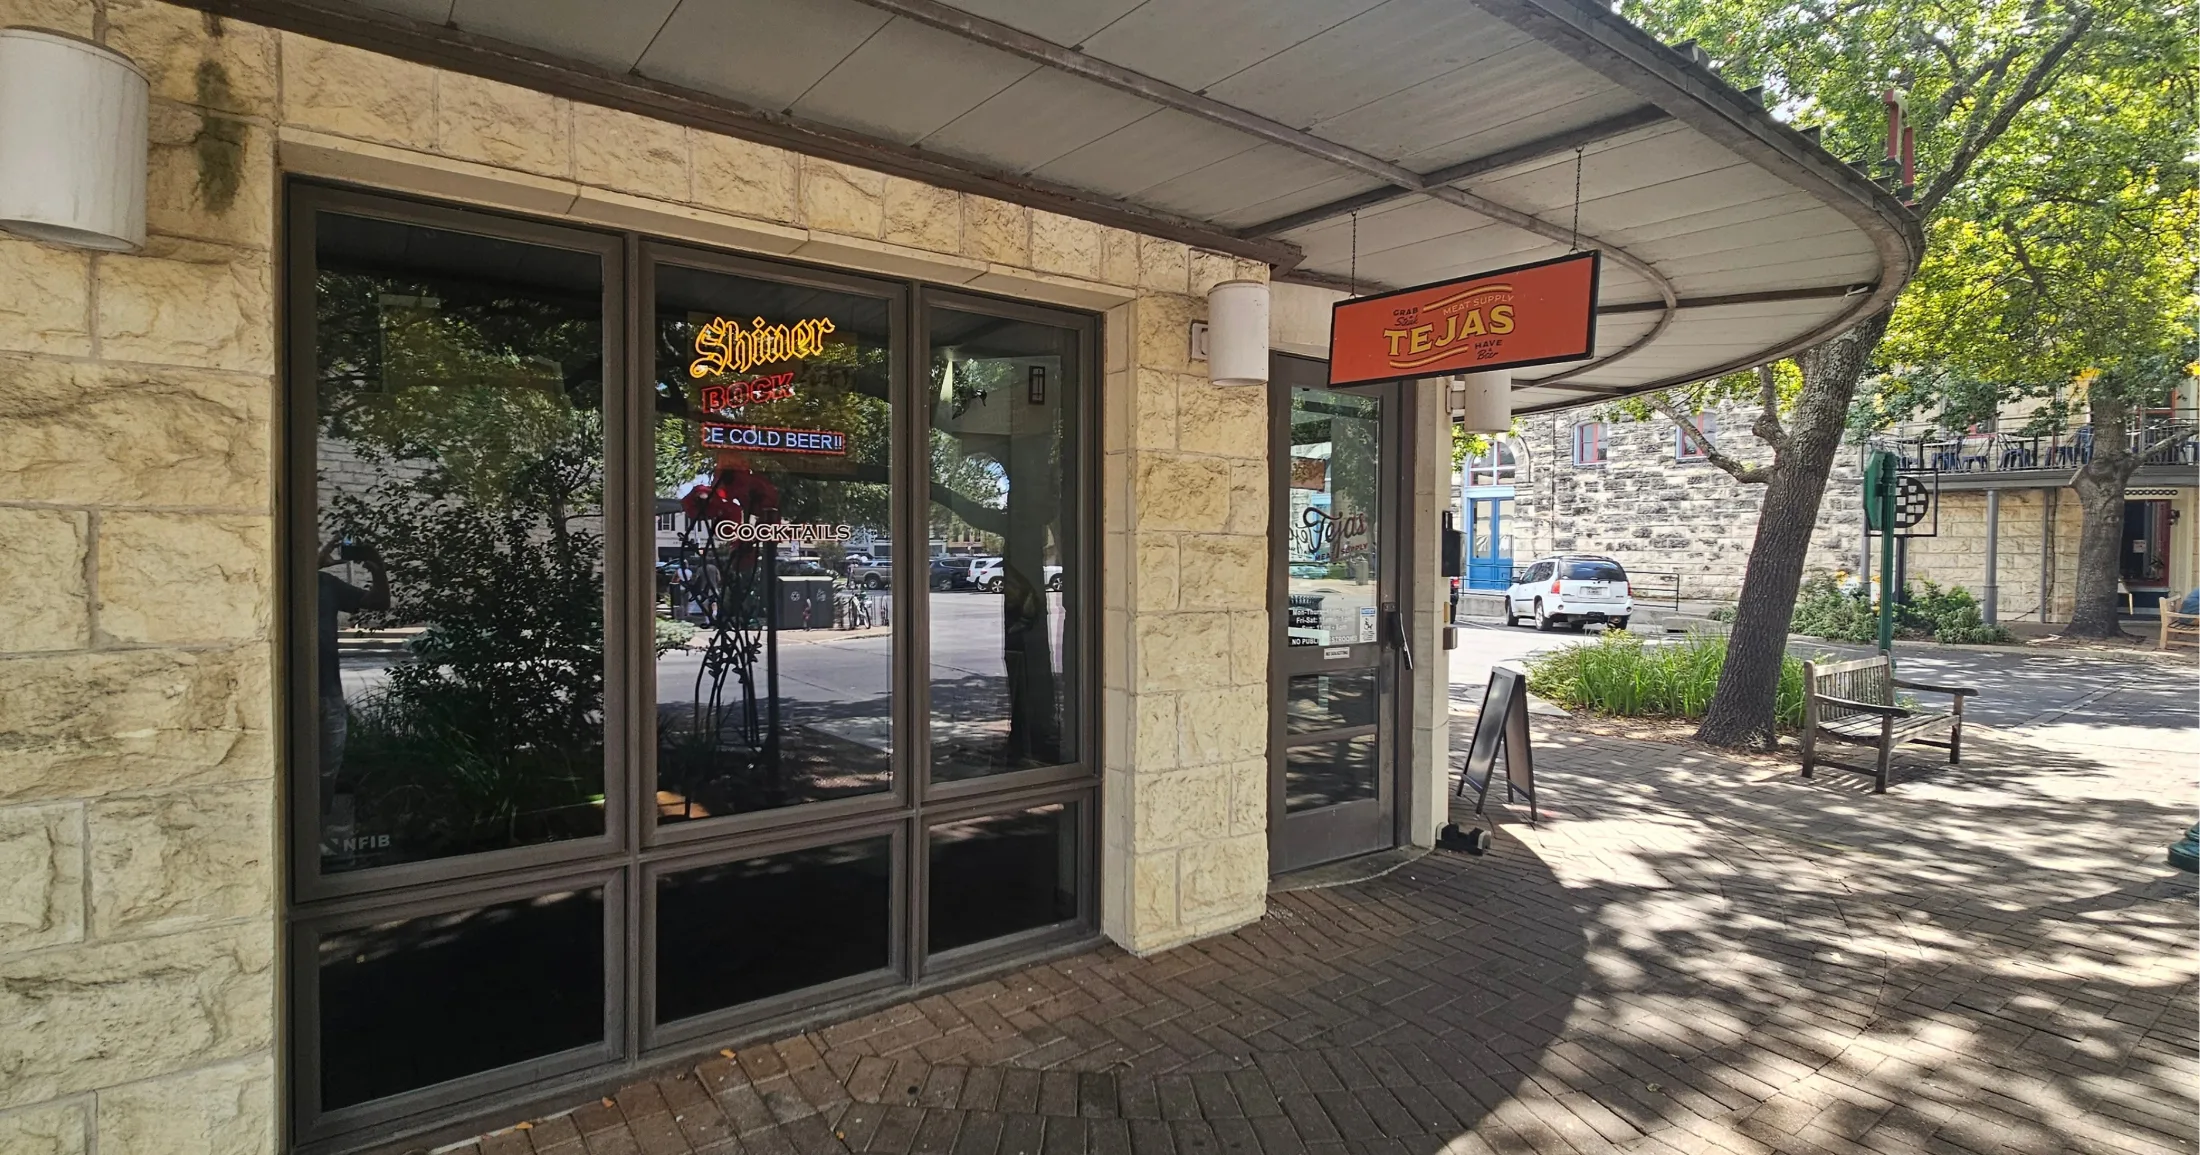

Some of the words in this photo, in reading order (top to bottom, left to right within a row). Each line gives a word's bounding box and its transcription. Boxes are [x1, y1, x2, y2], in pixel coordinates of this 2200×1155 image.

[1393, 307, 1419, 317] GRAB
[1443, 301, 1470, 316] MEAT
[1474, 294, 1515, 308] SUPPLY
[1383, 304, 1516, 356] TEJAS
[689, 316, 836, 378] Shiner
[1474, 339, 1503, 350] HAVE
[702, 373, 795, 413] BOCK
[703, 427, 724, 444] CE
[729, 429, 781, 447] COLD
[785, 432, 842, 450] BEER!!
[1303, 507, 1367, 559] Tejas
[343, 834, 390, 852] NFIB
